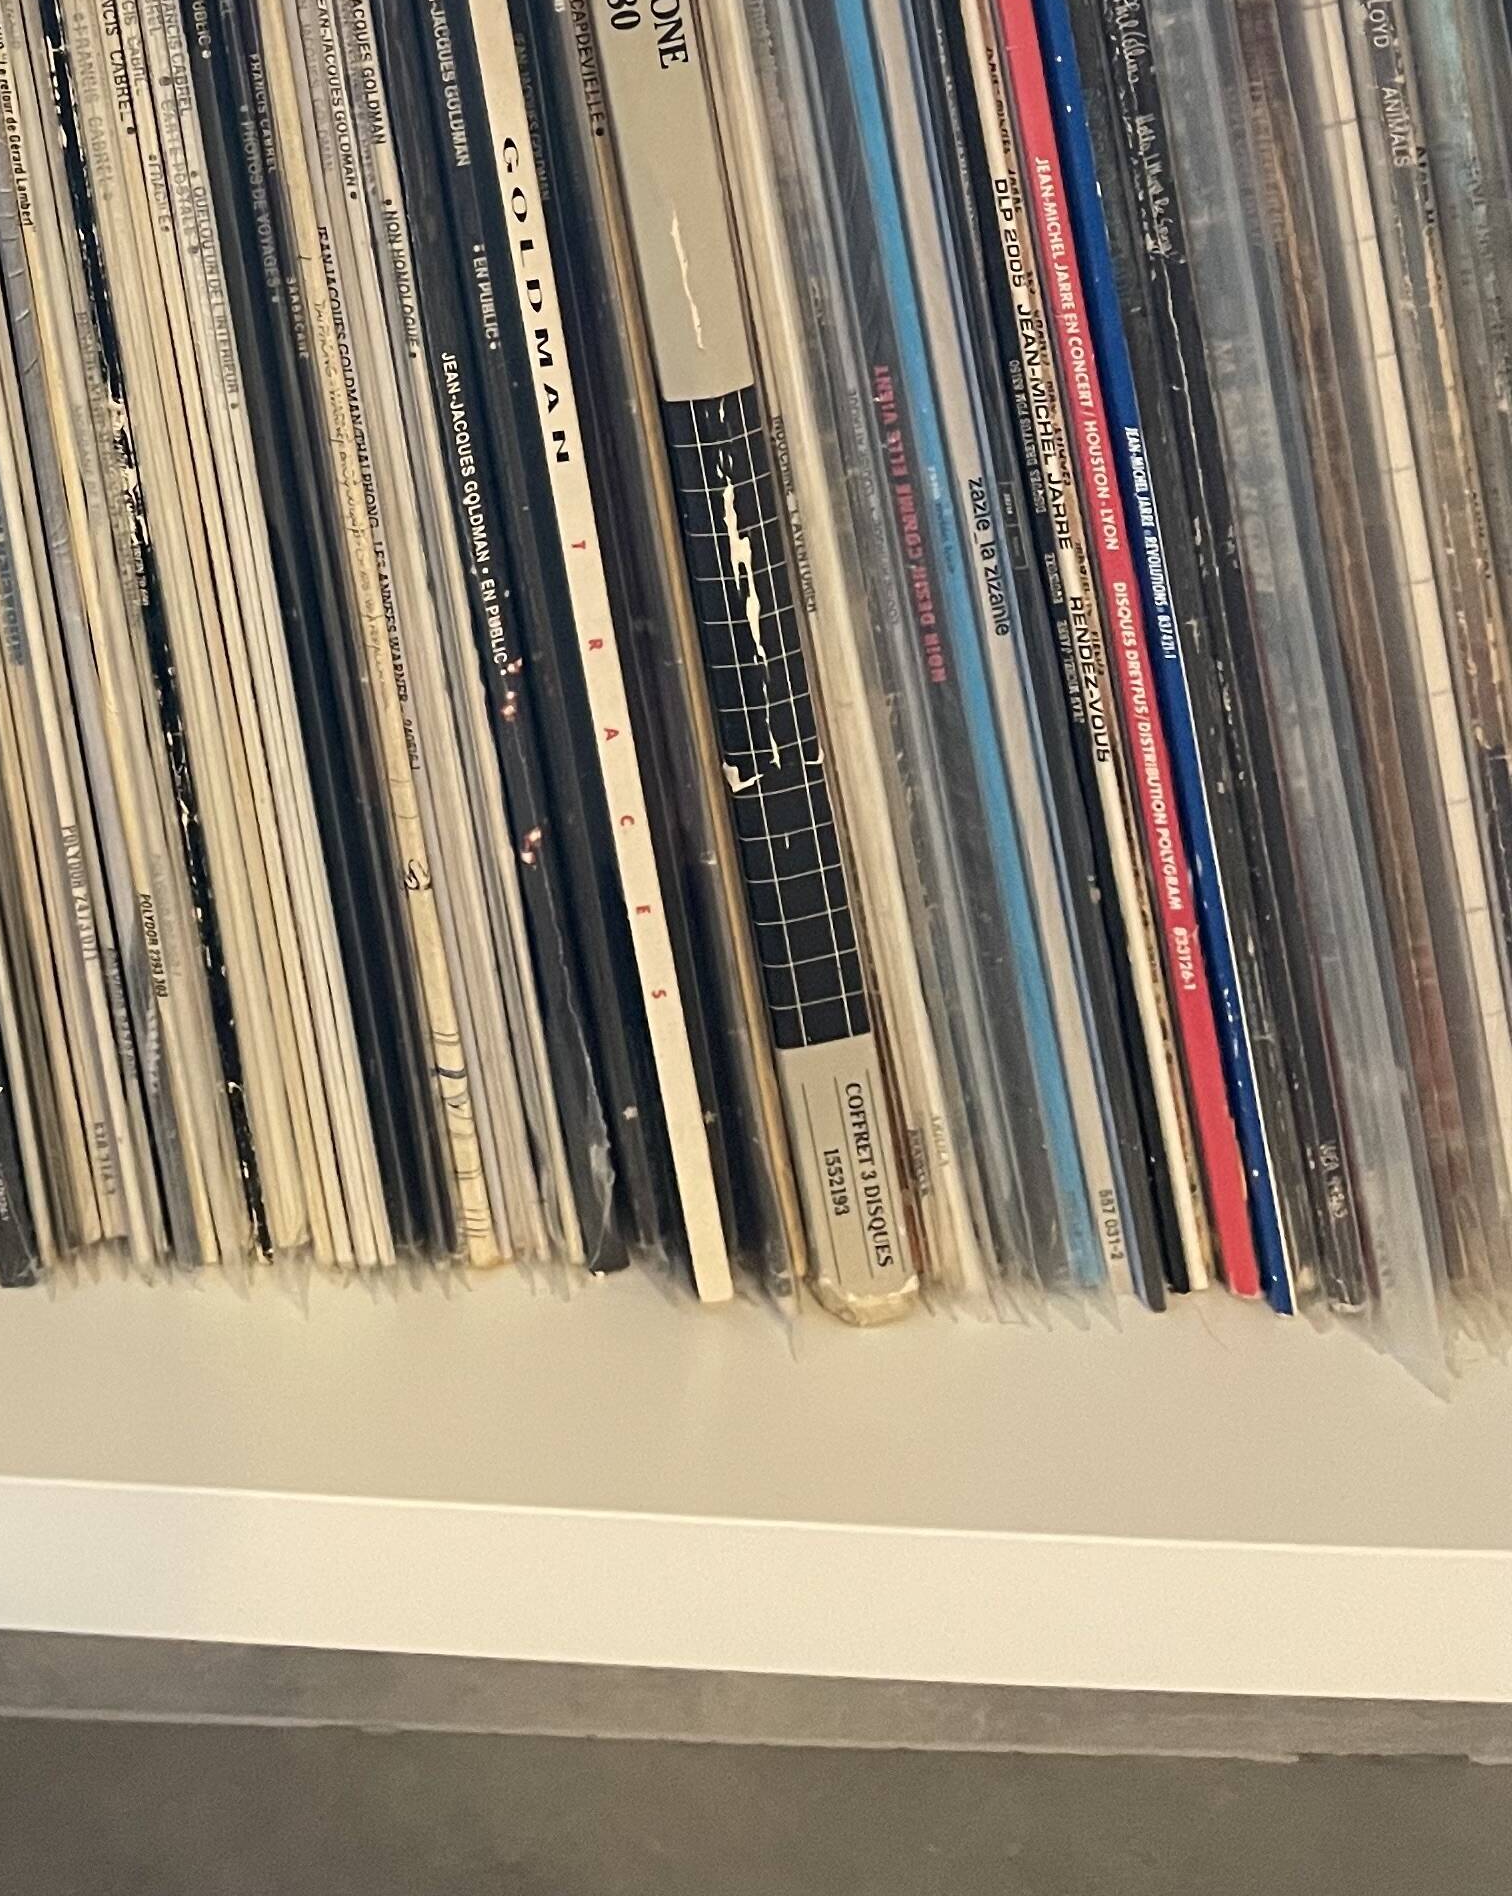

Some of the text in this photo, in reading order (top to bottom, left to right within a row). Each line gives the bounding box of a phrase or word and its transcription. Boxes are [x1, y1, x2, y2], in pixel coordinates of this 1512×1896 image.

[109, 49, 133, 122] CABREL
[170, 52, 193, 115] CABREL
[1119, 31, 1150, 83] Collins
[0, 78, 14, 113] retour
[5, 116, 18, 132] de
[442, 85, 469, 166] GOLDMAN
[1380, 85, 1411, 167] ANIMALS
[8, 134, 26, 175] Gérard
[333, 110, 357, 187] GOLDMAN
[361, 66, 386, 145] GOLDMAN
[384, 209, 402, 244] NON
[251, 187, 280, 287] DE VOYAGES
[1034, 155, 1066, 259] JEAN-MICHEL
[473, 256, 488, 278] EN
[499, 136, 571, 463] GOLDMAN
[1054, 261, 1076, 310] JARRE
[476, 281, 498, 339] PUBLIC
[1062, 312, 1079, 336] EN
[1067, 336, 1093, 408] CONCERT
[993, 178, 1014, 222] DLP
[1016, 302, 1057, 465] JEAN-MICHEL
[1046, 470, 1073, 551] JARRE
[1068, 595, 1112, 763] RENDEZ-VOUS
[1082, 419, 1110, 498] HOUSTON
[1123, 425, 1154, 528] JEAN-MICHEL JARRE
[440, 351, 508, 664] JEAN-JACQUES GOLDMAN EN PUBLIC
[872, 364, 945, 682] NOIR VIENT
[1098, 507, 1119, 551] LYON
[983, 564, 1012, 637] zizanie
[1112, 580, 1137, 647] DISQUES
[1155, 826, 1182, 911] POLYGRAM
[139, 892, 158, 946] POLYDOR
[822, 1148, 849, 1217] 1552193
[843, 1081, 894, 1268] COFFRET 3 DISQUES
